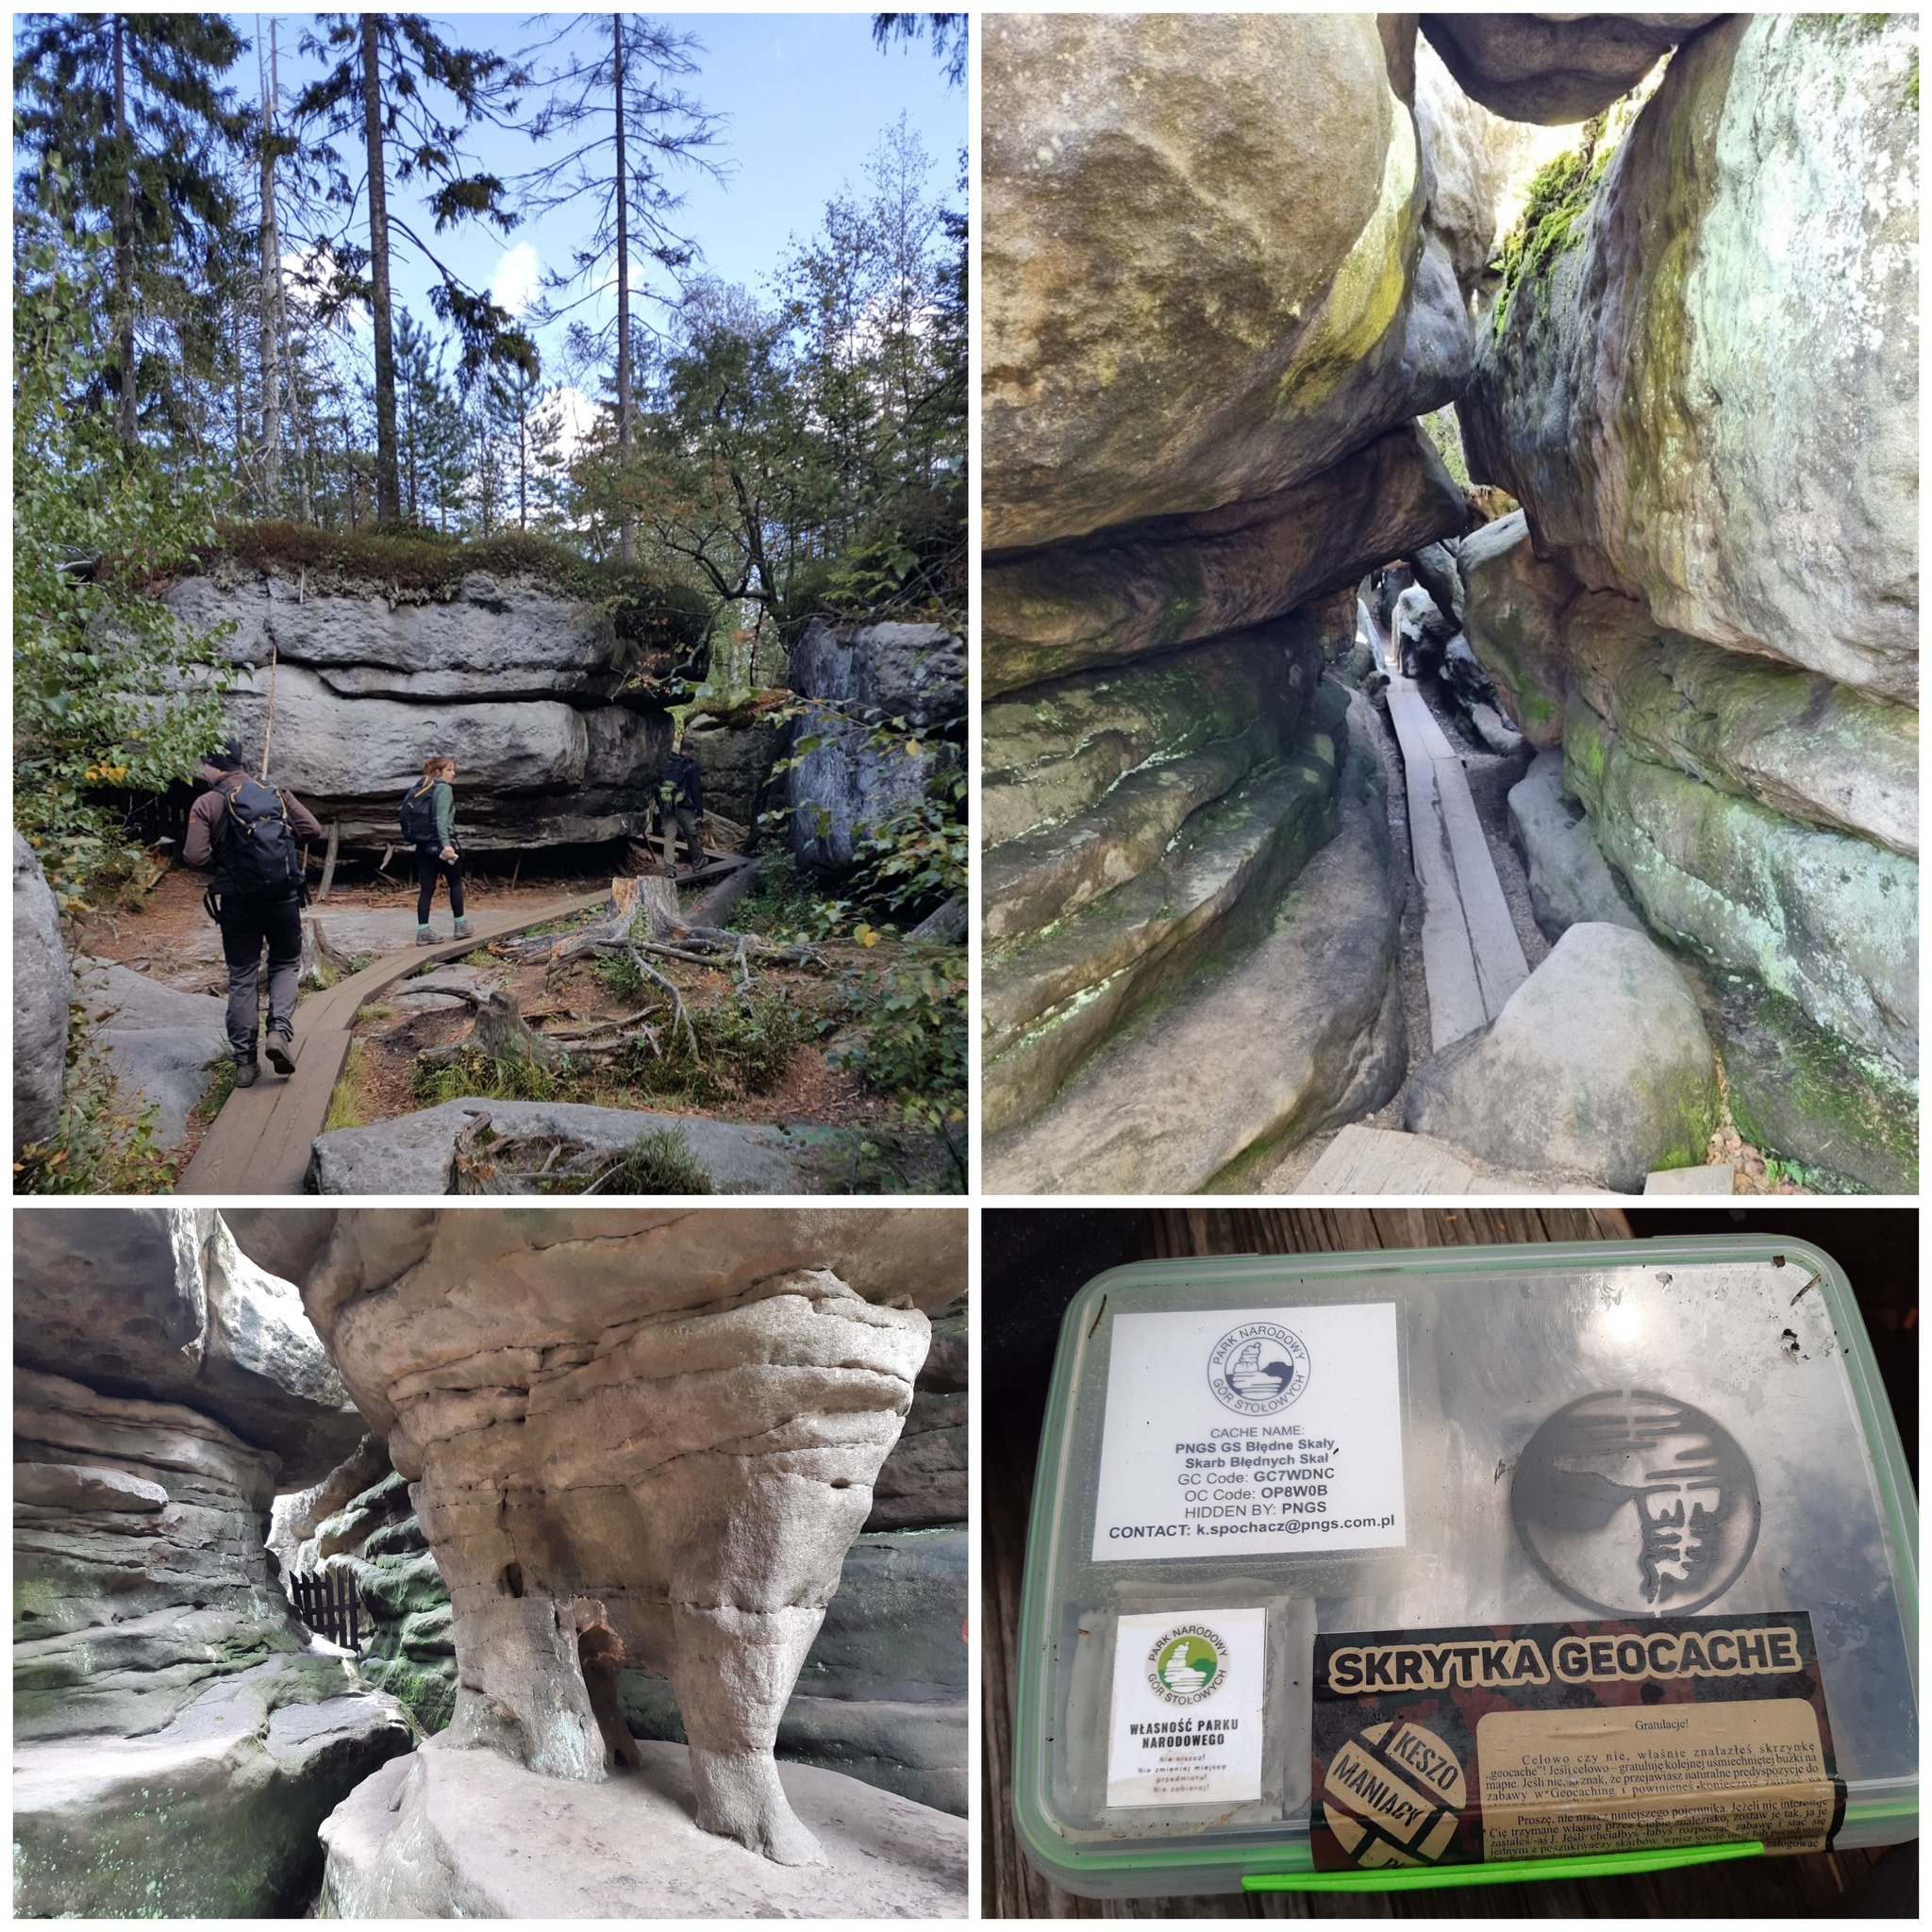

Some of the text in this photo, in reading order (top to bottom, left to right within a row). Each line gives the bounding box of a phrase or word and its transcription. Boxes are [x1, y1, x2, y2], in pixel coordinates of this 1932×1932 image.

[1213, 1324, 1307, 1365] PARK NARODOWY
[1213, 1373, 1307, 1413] GÓR STOŁOWYCH
[1210, 1425, 1305, 1439] CACHE NAME:
[1175, 1438, 1335, 1454] PNGS GS Błędne Skały
[1185, 1453, 1329, 1469] Skarb Błędnych Skał
[1177, 1468, 1335, 1486] GC Code: GC7WDNC
[1184, 1490, 1208, 1502] OC
[1213, 1489, 1255, 1501] Code:
[1185, 1501, 1326, 1519] HIDDEN BY: PNGS
[1108, 1514, 1395, 1539] CONTACT: k.spochacz@pngs.com.pl
[1149, 1625, 1227, 1661] PARK NARODOWY
[1334, 1631, 1796, 1688] SKRYTKA GEOCACHE
[1148, 1669, 1227, 1706] GÓR STOŁOWYCH
[1130, 1718, 1239, 1736] WŁASNOŚĆ PARKU
[1635, 1718, 1689, 1731] Gratulacje!
[1141, 1733, 1225, 1749] NARODOWEGO
[1522, 1741, 1815, 1765] Celowo czy nie, właśnie znalazłeś skrzynkę
[1393, 1730, 1458, 1790] KESZO
[1548, 1764, 1571, 1775] Jeśli
[1573, 1763, 1609, 1774] celowo
[1619, 1759, 1664, 1774] gratuluję
[1665, 1757, 1705, 1771] kolejnej
[1707, 1754, 1774, 1767] uśmiechniętej
[1805, 1754, 1817, 1762] na
[1486, 1778, 1520, 1791] mapie.
[1523, 1776, 1544, 1788] Jeśli
[1547, 1776, 1566, 1788] nie,
[1580, 1774, 1607, 1786] znak,
[1609, 1774, 1622, 1784] że
[1623, 1771, 1683, 1785] przejawiasz
[1685, 1768, 1731, 1780] naturalne
[1733, 1764, 1804, 1780] predyspozycje
[1806, 1763, 1819, 1774] do
[1332, 1754, 1424, 1827] MANIACY
[1487, 1790, 1527, 1802] zabawy
[1550, 1786, 1615, 1799] Geocaching
[1632, 1781, 1694, 1797] powinieneś
[1699, 1777, 1757, 1790] koniecznie
[1511, 1826, 1559, 1837] trzymane
[1562, 1821, 1602, 1833] właśnie
[1606, 1821, 1634, 1832] przez
[1733, 1811, 1768, 1822] zostaw
[1517, 1814, 1555, 1825] Proszę,
[1557, 1812, 1574, 1823] nie
[1611, 1808, 1670, 1821] niniejszego
[1672, 1804, 1728, 1819] pojemnika.
[1731, 1800, 1759, 1812] Jeżeli
[1762, 1800, 1778, 1810] nie
[1561, 1833, 1586, 1842] Jeśli
[1490, 1845, 1528, 1857] jednym
